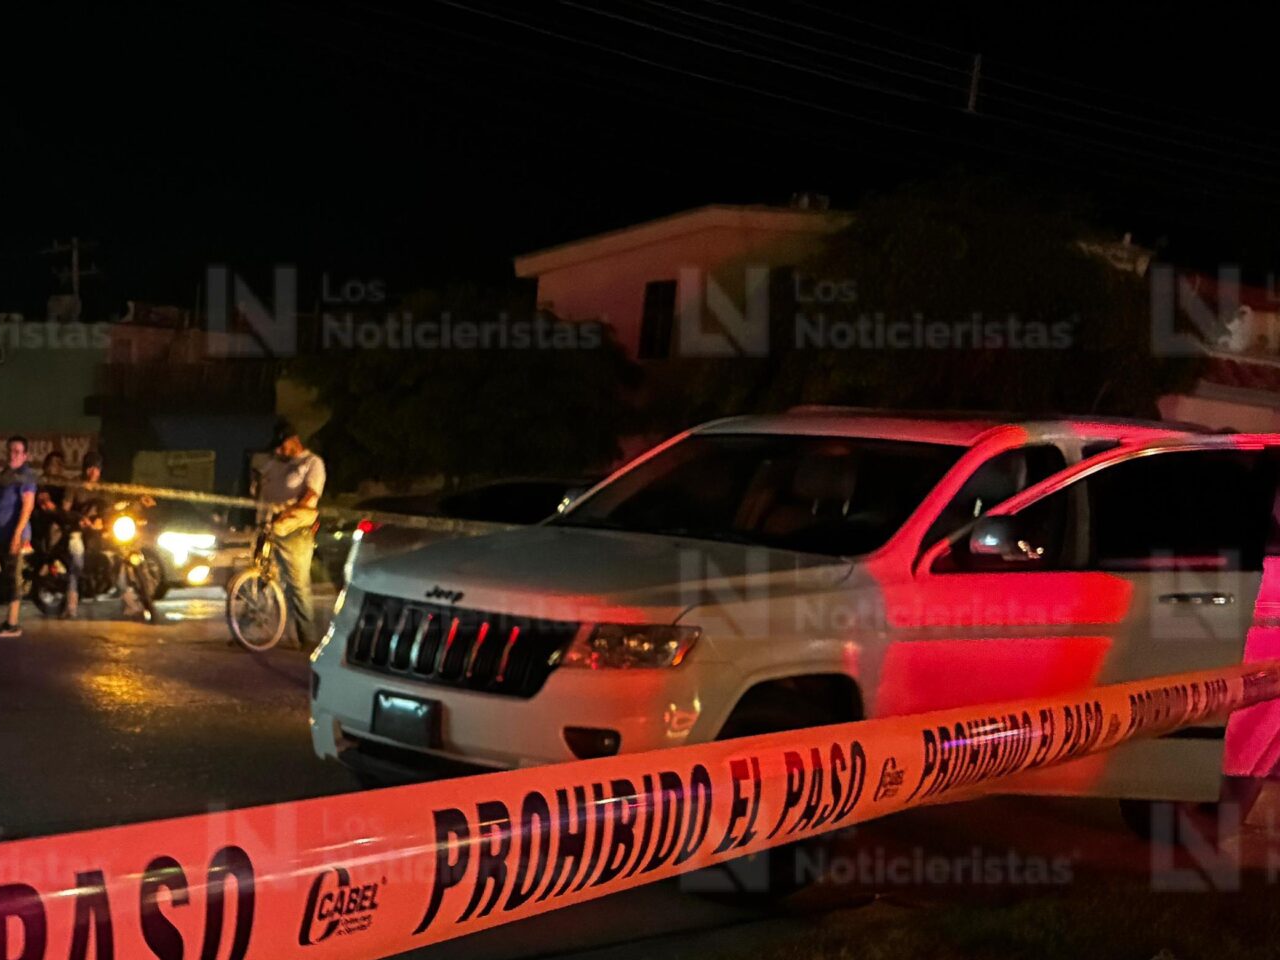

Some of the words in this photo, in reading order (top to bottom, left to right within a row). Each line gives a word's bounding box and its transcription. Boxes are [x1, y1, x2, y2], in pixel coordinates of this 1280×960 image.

[425, 585, 465, 604] Jeep
[412, 763, 713, 935] PROHIBIDO
[713, 756, 761, 855] EL
[766, 740, 867, 840] PASO
